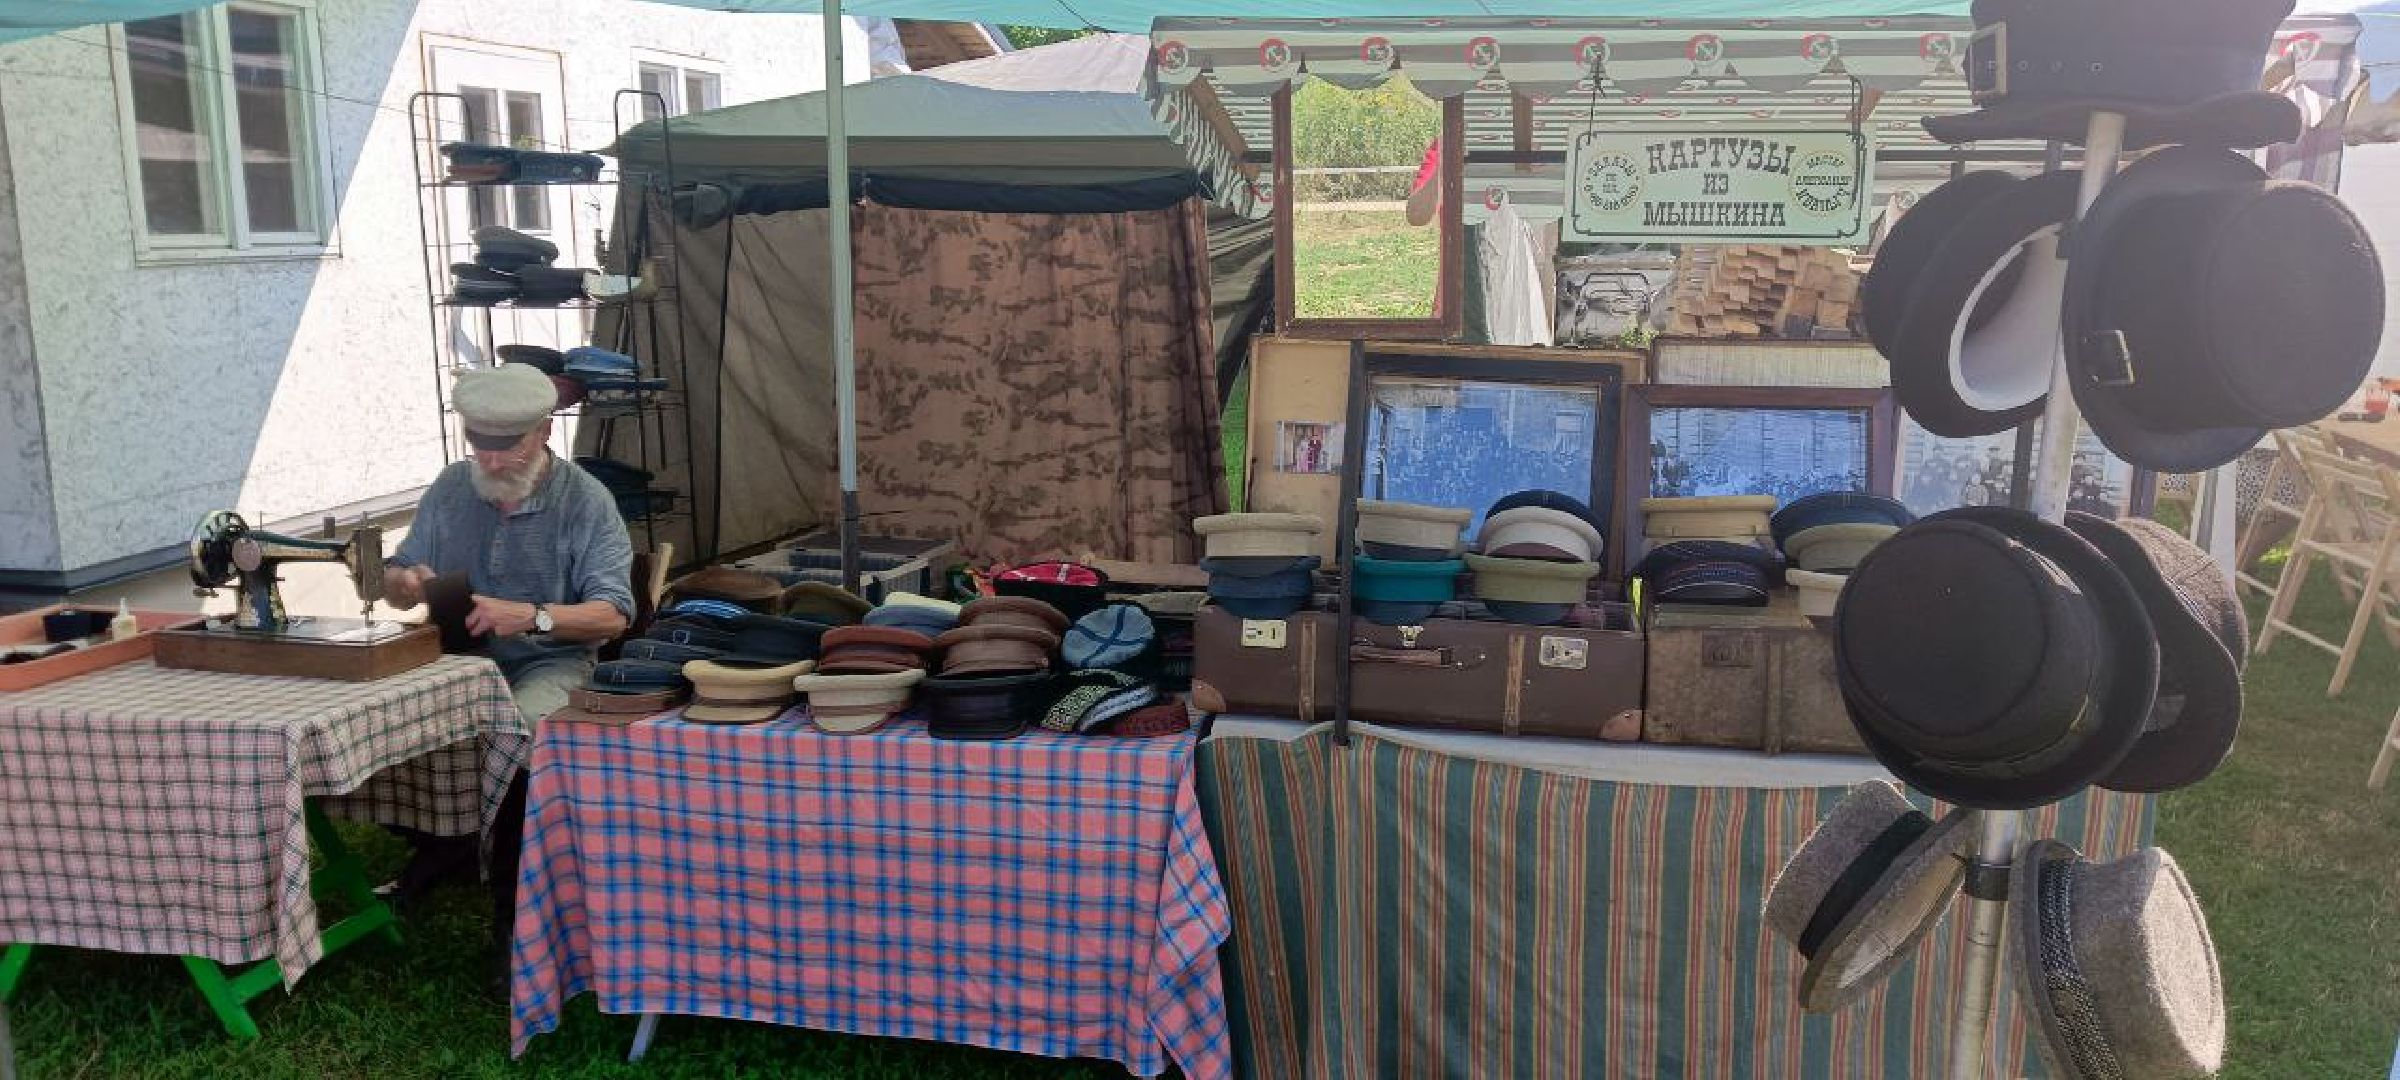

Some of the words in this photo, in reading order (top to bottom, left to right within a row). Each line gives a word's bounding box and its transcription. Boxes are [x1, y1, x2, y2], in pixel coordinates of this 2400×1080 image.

[1646, 138, 1797, 175] КАРТУЗЫ
[1702, 173, 1729, 195] ИЗ
[1643, 201, 1786, 227] МЫШКИНА
